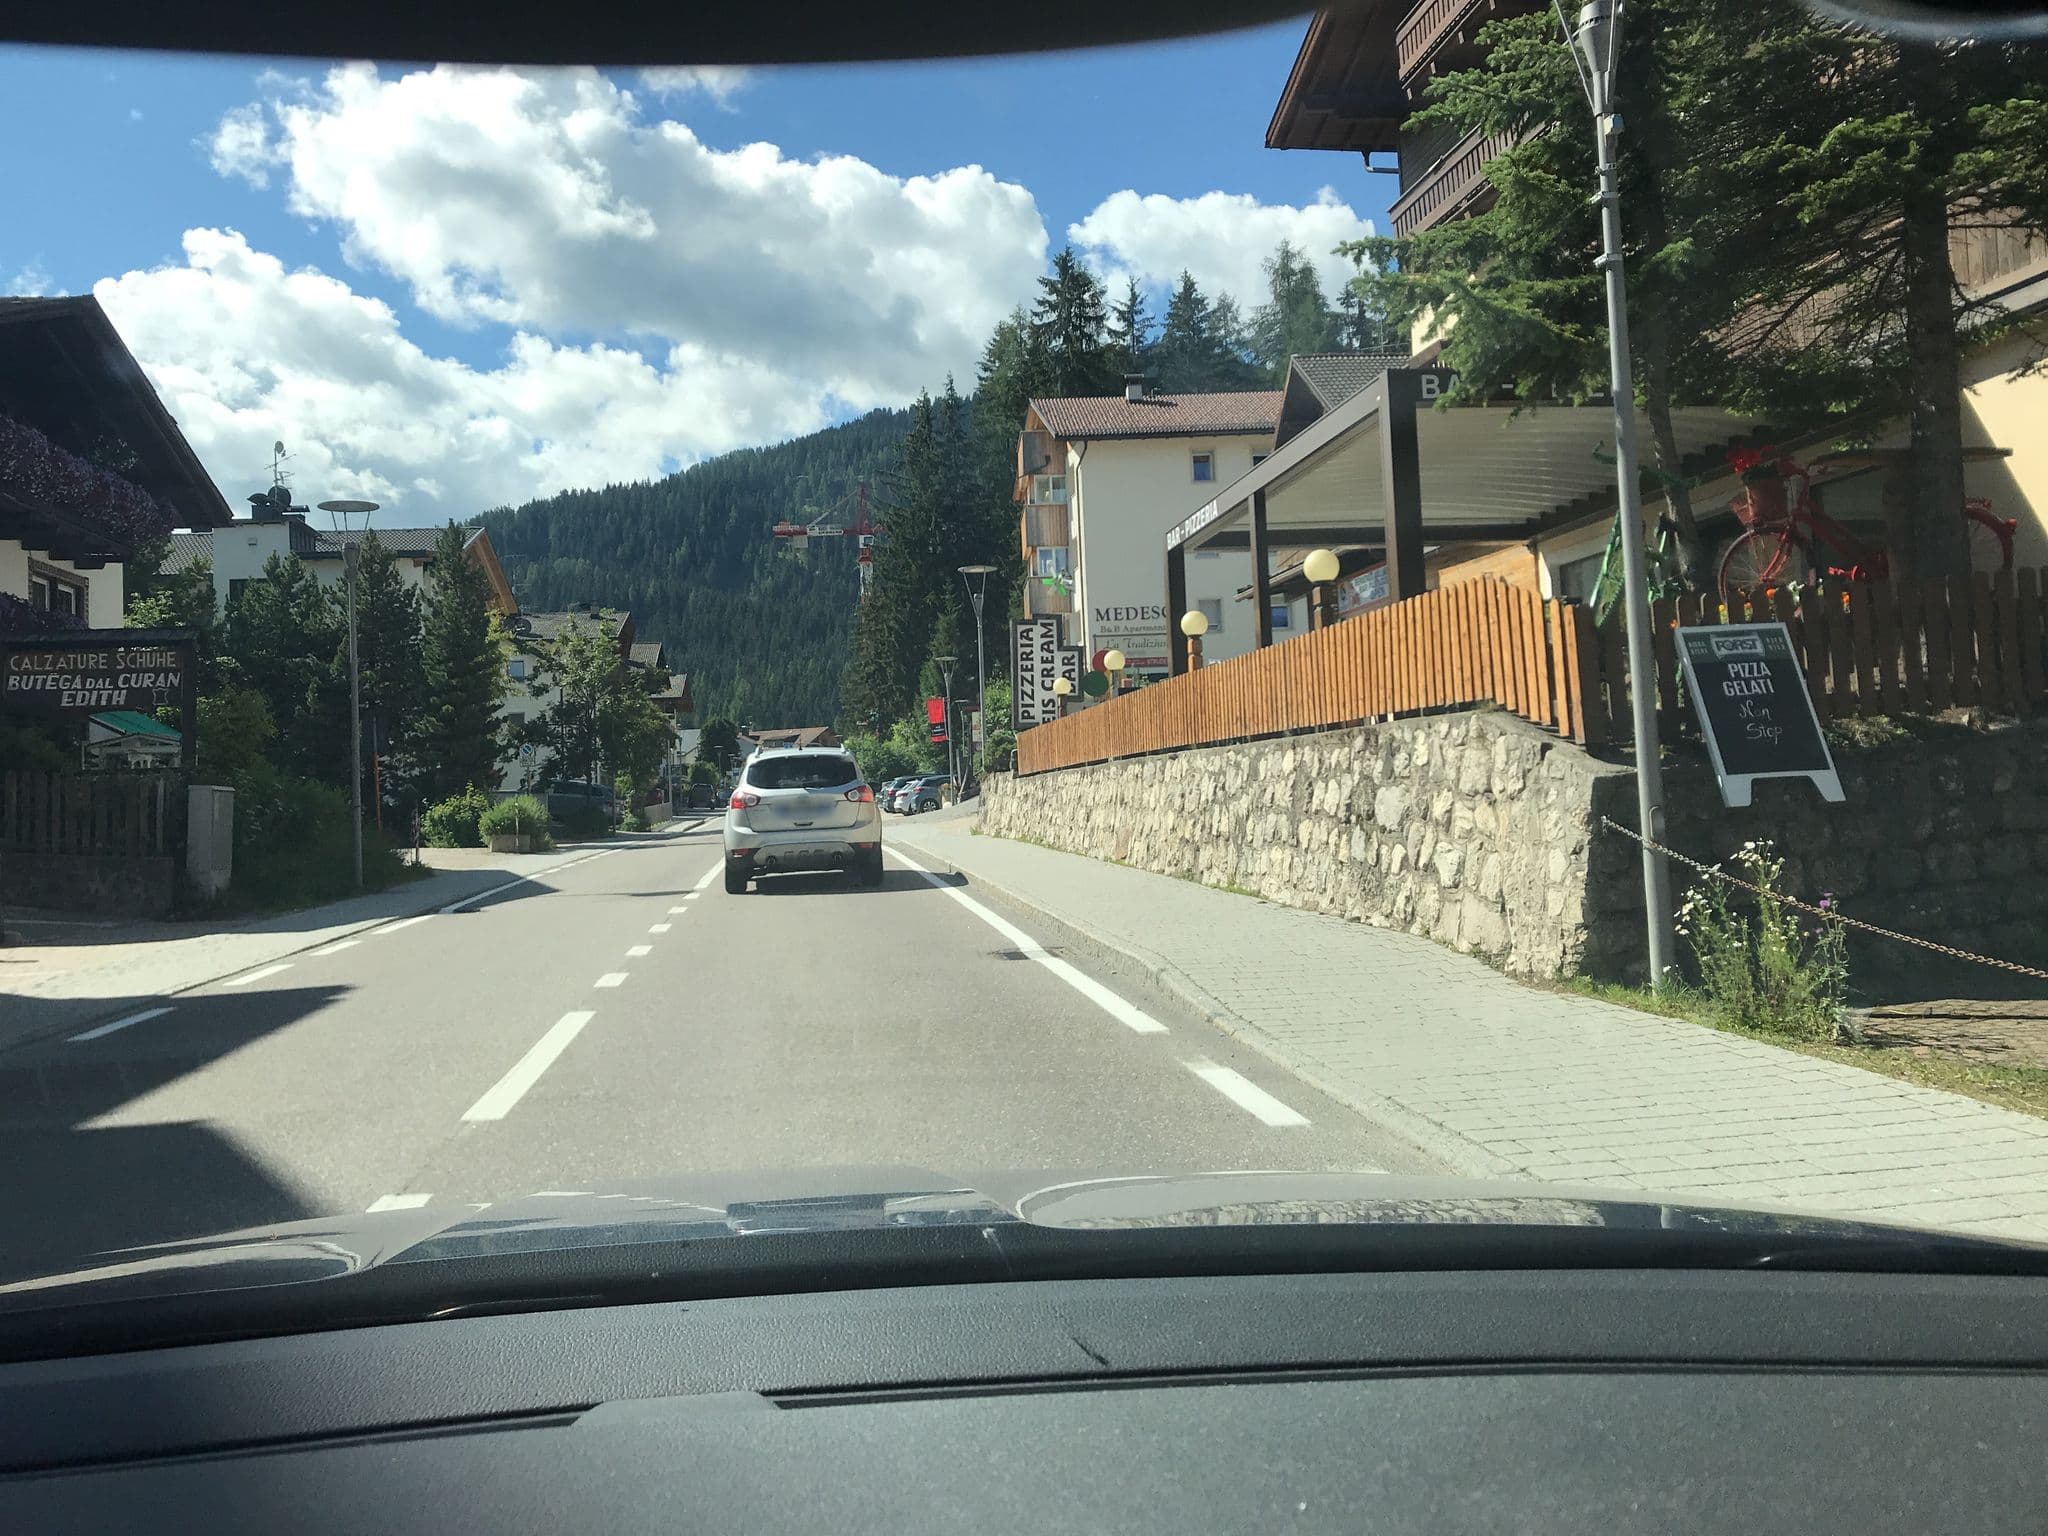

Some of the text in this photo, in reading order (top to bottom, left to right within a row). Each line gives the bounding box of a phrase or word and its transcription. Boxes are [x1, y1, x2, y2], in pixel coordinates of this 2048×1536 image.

[1167, 527, 1181, 551] BAR
[1185, 500, 1218, 538] PIZZERIA
[10, 652, 177, 671] CALZATURE SCHUHE
[1040, 622, 1055, 691] CREAM
[1020, 627, 1035, 721] PIZZERIA
[1727, 662, 1772, 678] PIZZA
[7, 672, 181, 691] BUTËGA DAL CURAN
[1722, 680, 1775, 696] GELATI
[60, 690, 127, 707] EDITH
